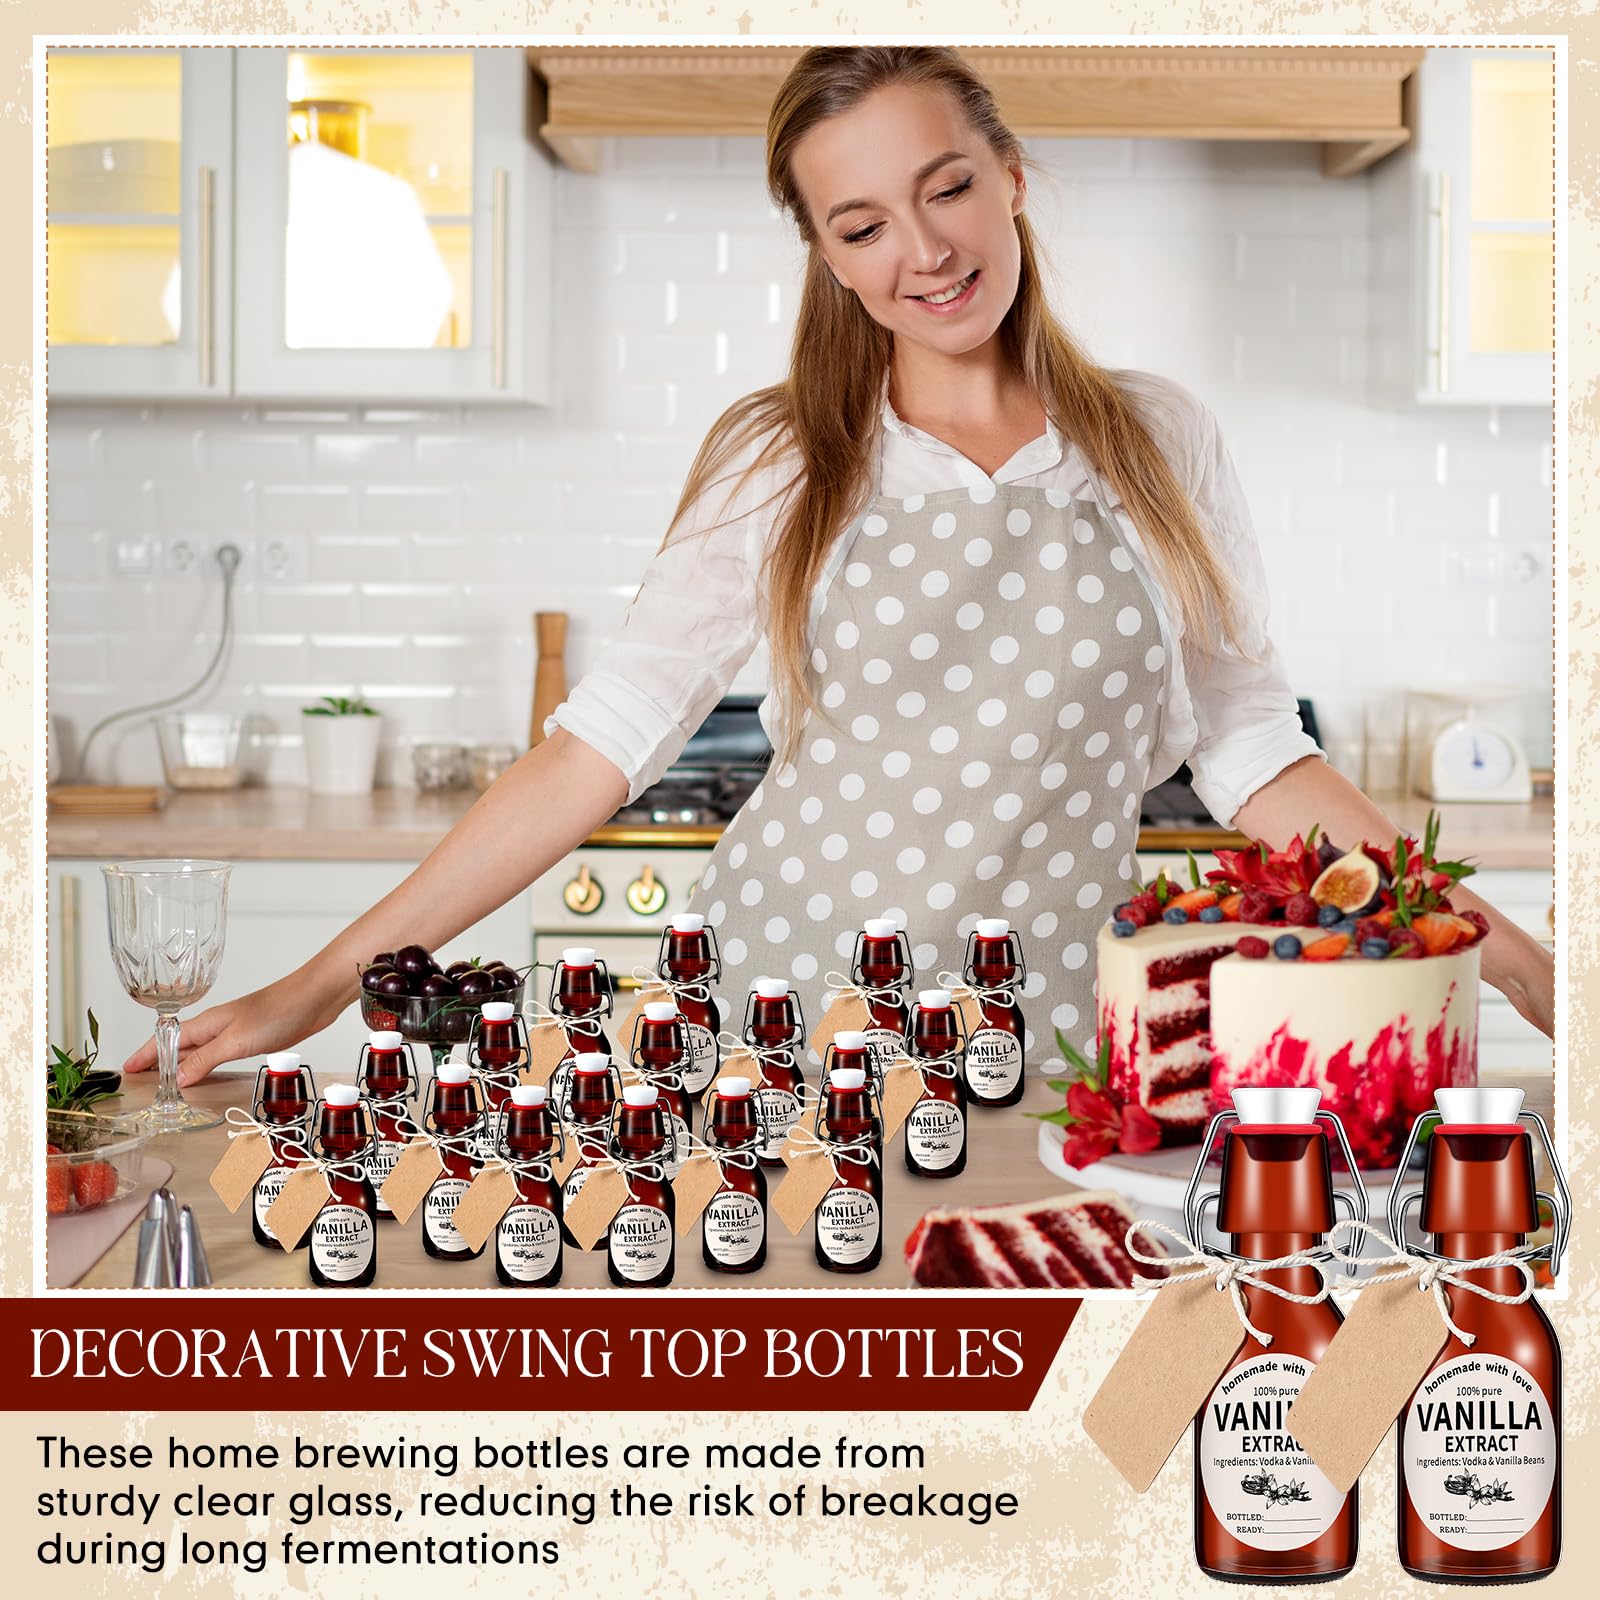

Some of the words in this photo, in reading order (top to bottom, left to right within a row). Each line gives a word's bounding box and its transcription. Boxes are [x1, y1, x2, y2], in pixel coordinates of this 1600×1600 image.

[968, 1042, 1017, 1056] VANILLA
[978, 1055, 1008, 1063] EXTRACT
[910, 1113, 959, 1127] VANILLA
[920, 1126, 951, 1134] EXTRACT
[707, 1206, 759, 1220] VANILLA
[820, 1203, 874, 1217] VANILLA
[314, 1220, 368, 1234] VANILLA
[501, 1220, 554, 1234] VANILLA
[612, 1220, 666, 1234] VANILLA
[718, 1219, 750, 1228] EXTRACT
[832, 1217, 864, 1225] EXTRACT
[326, 1234, 359, 1242] EXTRACT
[512, 1234, 545, 1242] EXTRACT
[624, 1234, 657, 1242] EXTRACT
[1222, 1361, 1278, 1395] homemade
[1283, 1363, 1305, 1376] with
[1425, 1361, 1481, 1395] homemade
[1486, 1363, 1508, 1376] with
[1512, 1370, 1532, 1393] love
[1254, 1387, 1277, 1396] 100%
[1279, 1388, 1299, 1397] pure
[1456, 1386, 1480, 1396] 100%
[1482, 1388, 1502, 1397] pure
[1214, 1401, 1293, 1432] VANI
[1417, 1401, 1542, 1432] VANILLA
[1445, 1435, 1518, 1452] EXTRACT
[1213, 1458, 1257, 1468] Ingredients:
[1259, 1457, 1284, 1466] Vodka
[1285, 1457, 1291, 1466] &
[1416, 1457, 1460, 1468] Ingredients:
[1462, 1457, 1486, 1466] Vodka
[1488, 1457, 1494, 1466] &
[1495, 1456, 1522, 1465] Vanilla
[1523, 1456, 1545, 1464] Beans
